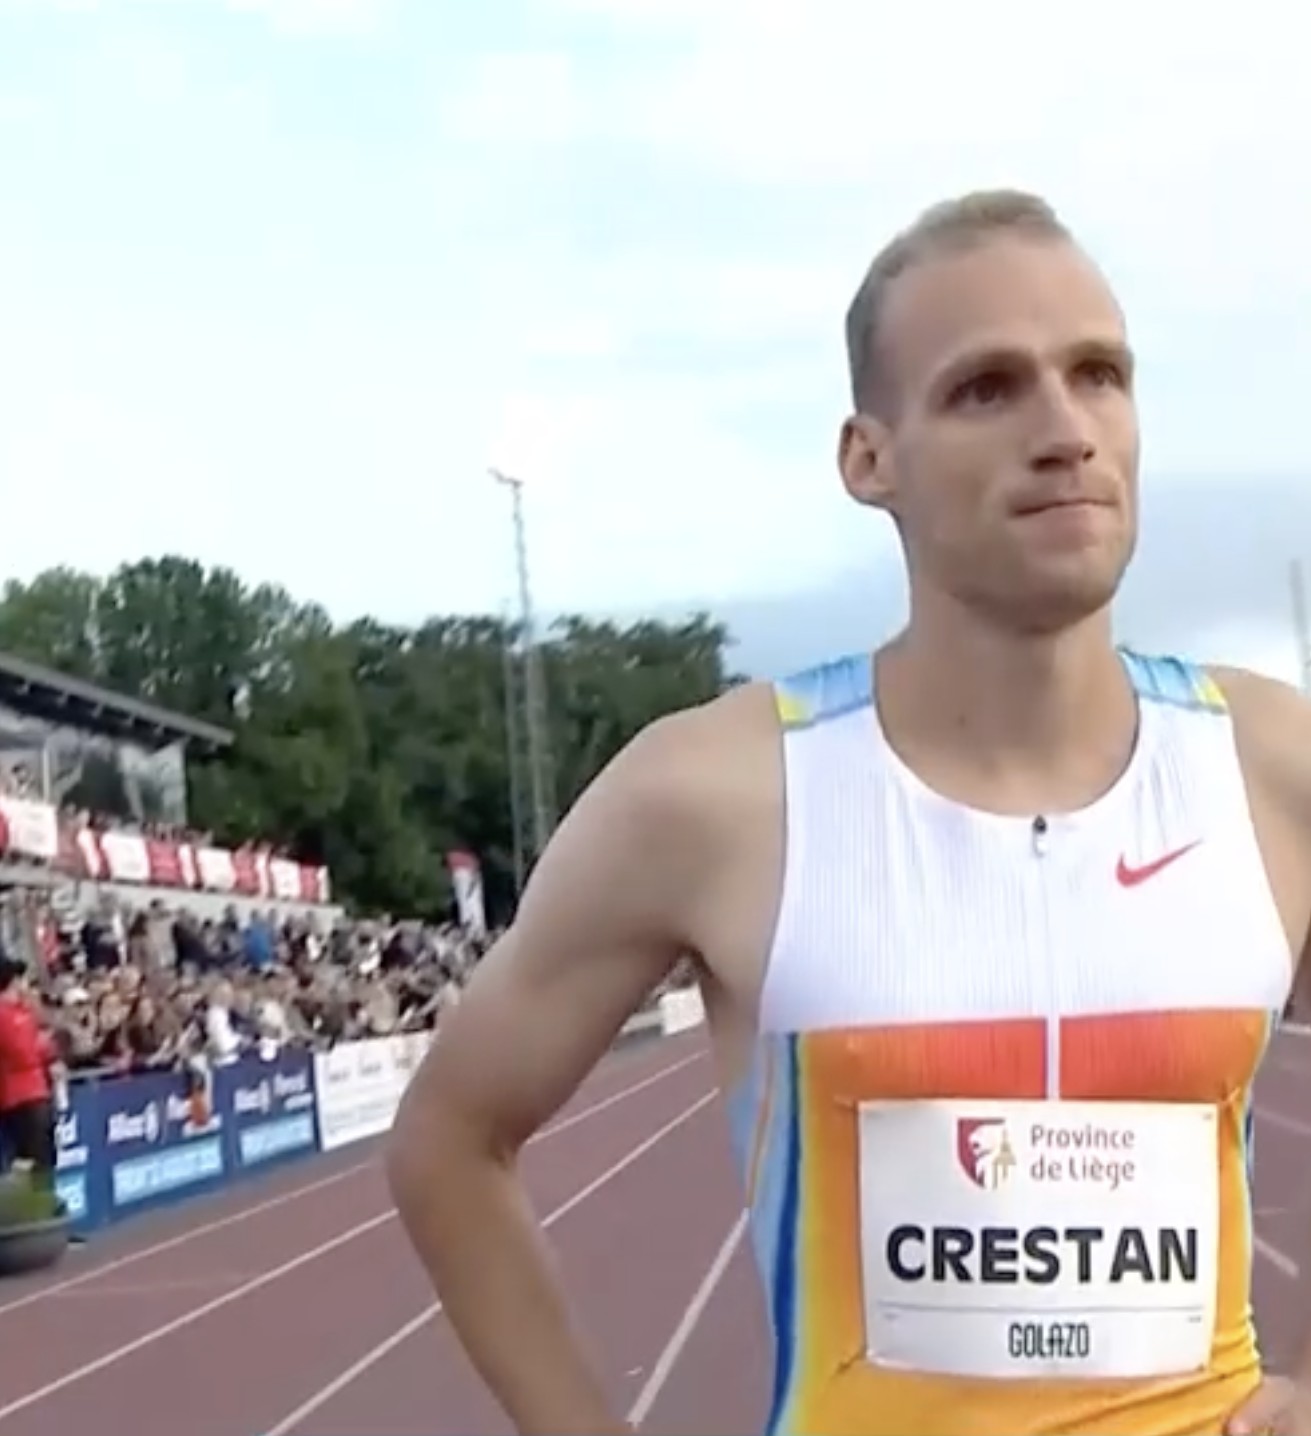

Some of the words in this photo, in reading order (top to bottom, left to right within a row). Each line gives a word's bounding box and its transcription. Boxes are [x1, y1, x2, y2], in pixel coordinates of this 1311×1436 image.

[1030, 1123, 1135, 1150] Province
[1030, 1153, 1063, 1181] de
[1068, 1156, 1135, 1191] Liège
[885, 1224, 1199, 1284] CRESTAN
[1008, 1321, 1091, 1358] GOLAZO
